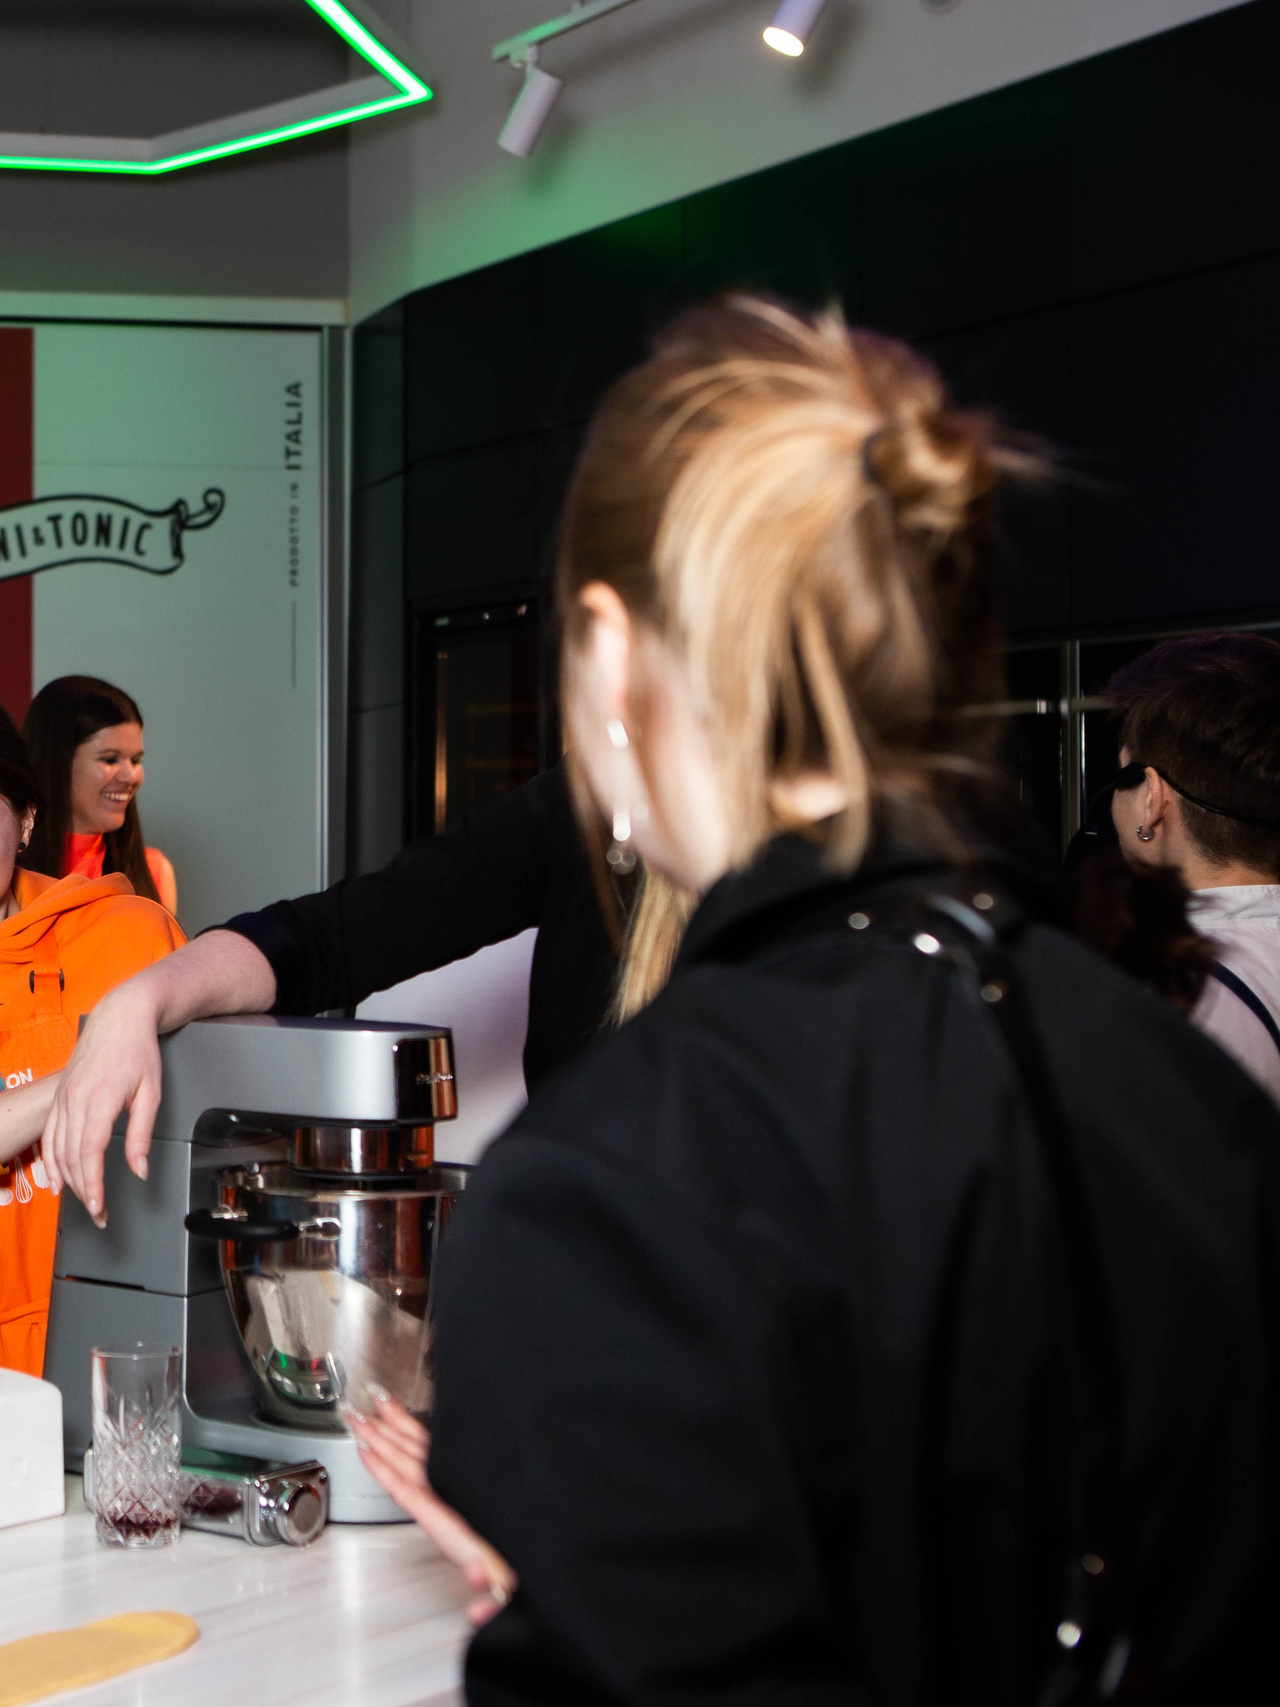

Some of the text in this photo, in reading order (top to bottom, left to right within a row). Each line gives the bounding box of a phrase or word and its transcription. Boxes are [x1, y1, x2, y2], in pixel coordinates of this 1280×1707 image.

[284, 380, 303, 588] PRODOTTO IN ITALIA
